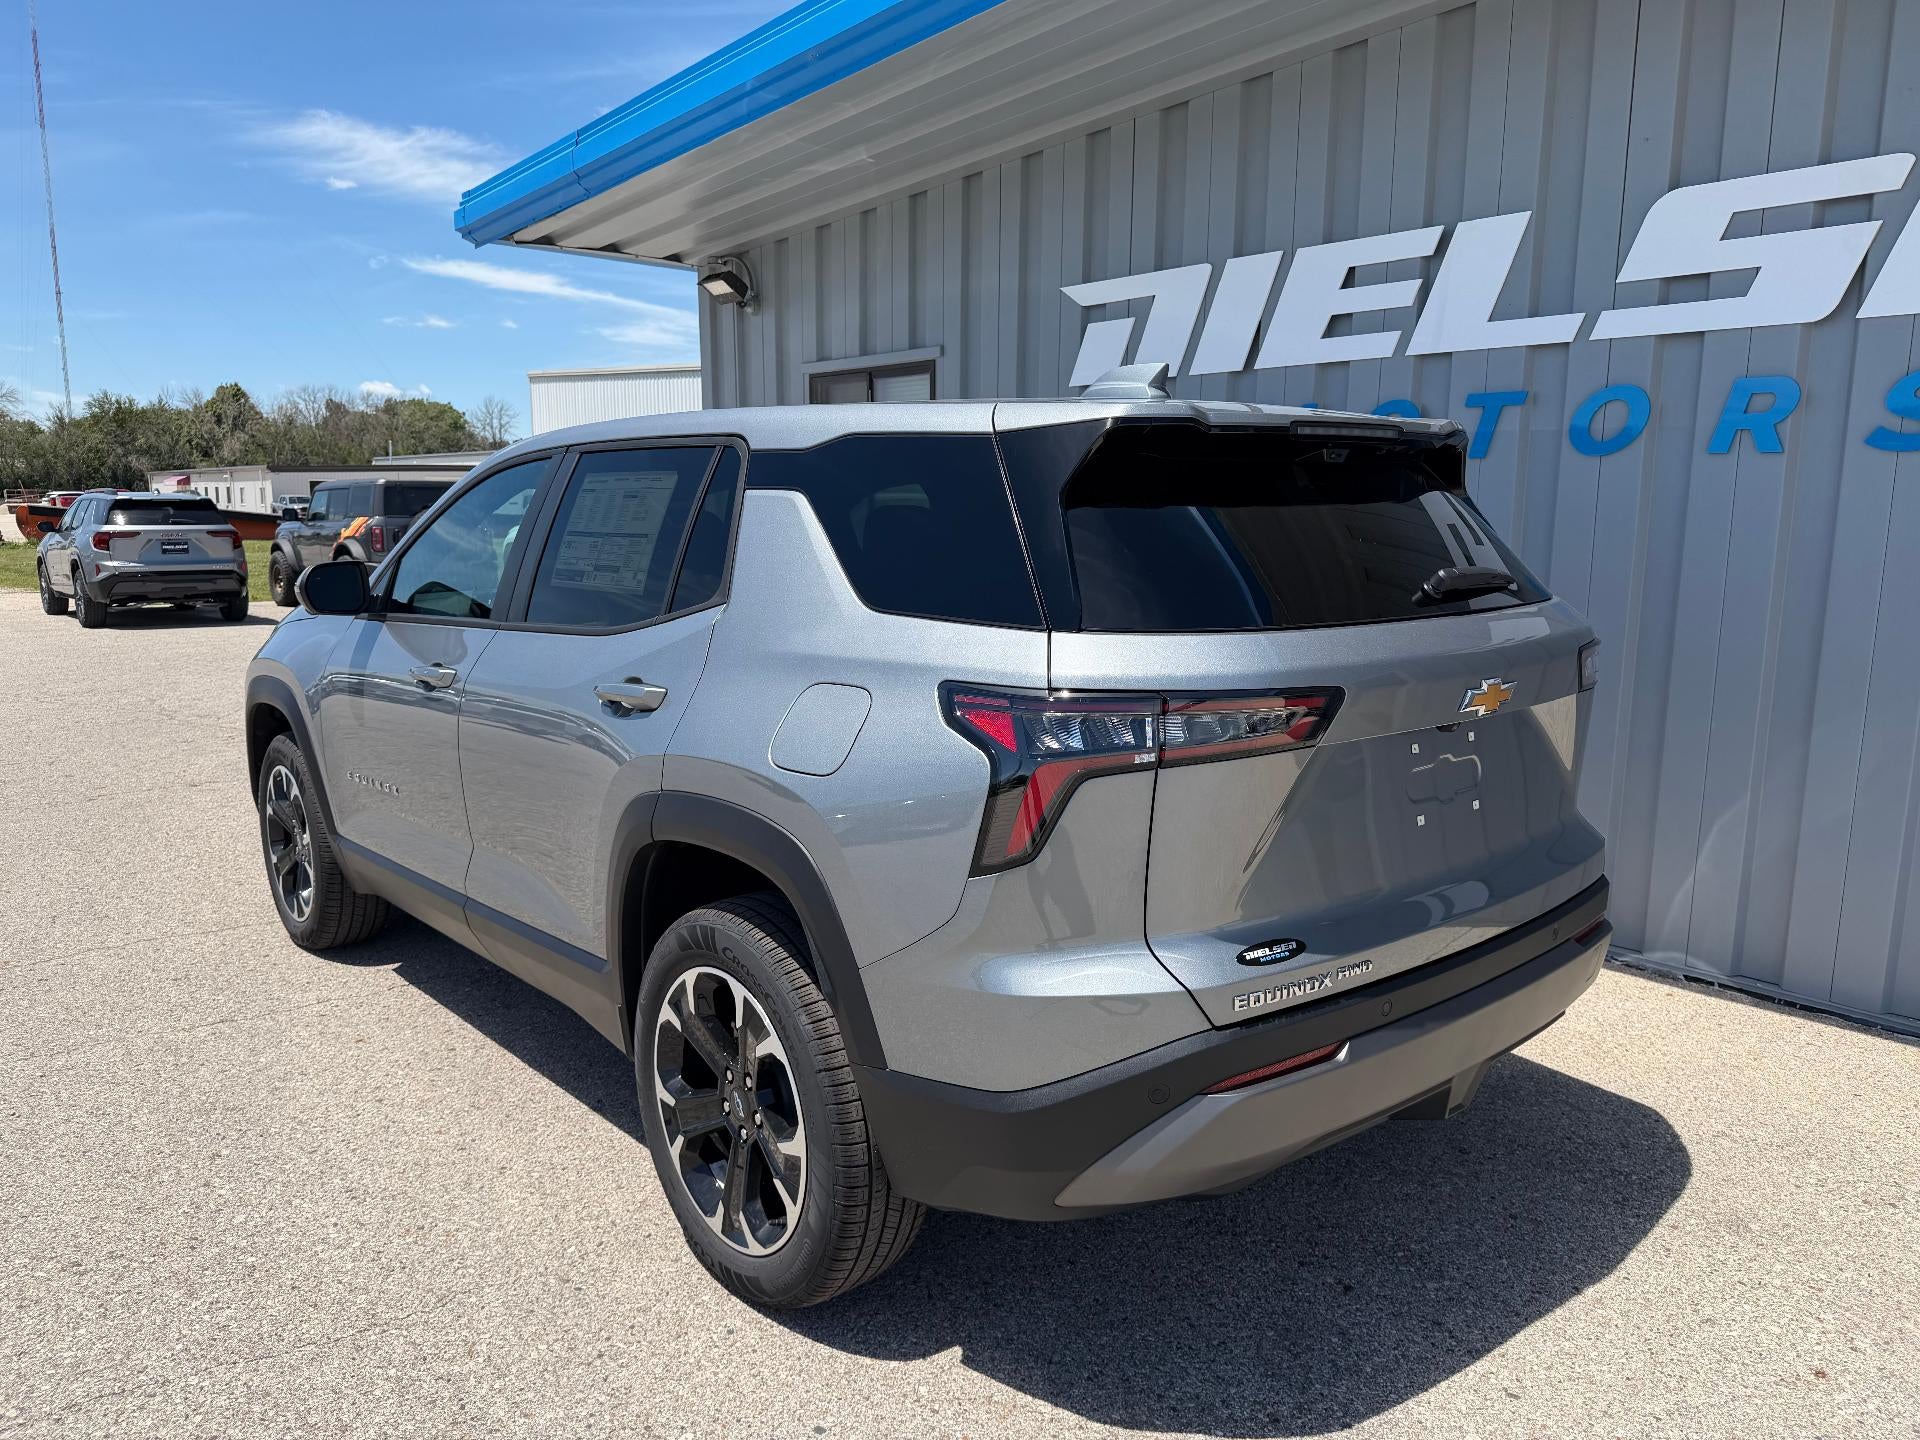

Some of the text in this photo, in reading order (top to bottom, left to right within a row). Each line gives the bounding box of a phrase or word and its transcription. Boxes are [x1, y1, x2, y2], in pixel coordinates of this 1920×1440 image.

[1060, 152, 1920, 386] DIELS
[1302, 371, 1920, 459] TORS
[1233, 959, 1373, 1012] EQUINOX AWD
[1260, 951, 1290, 963] MOTORS
